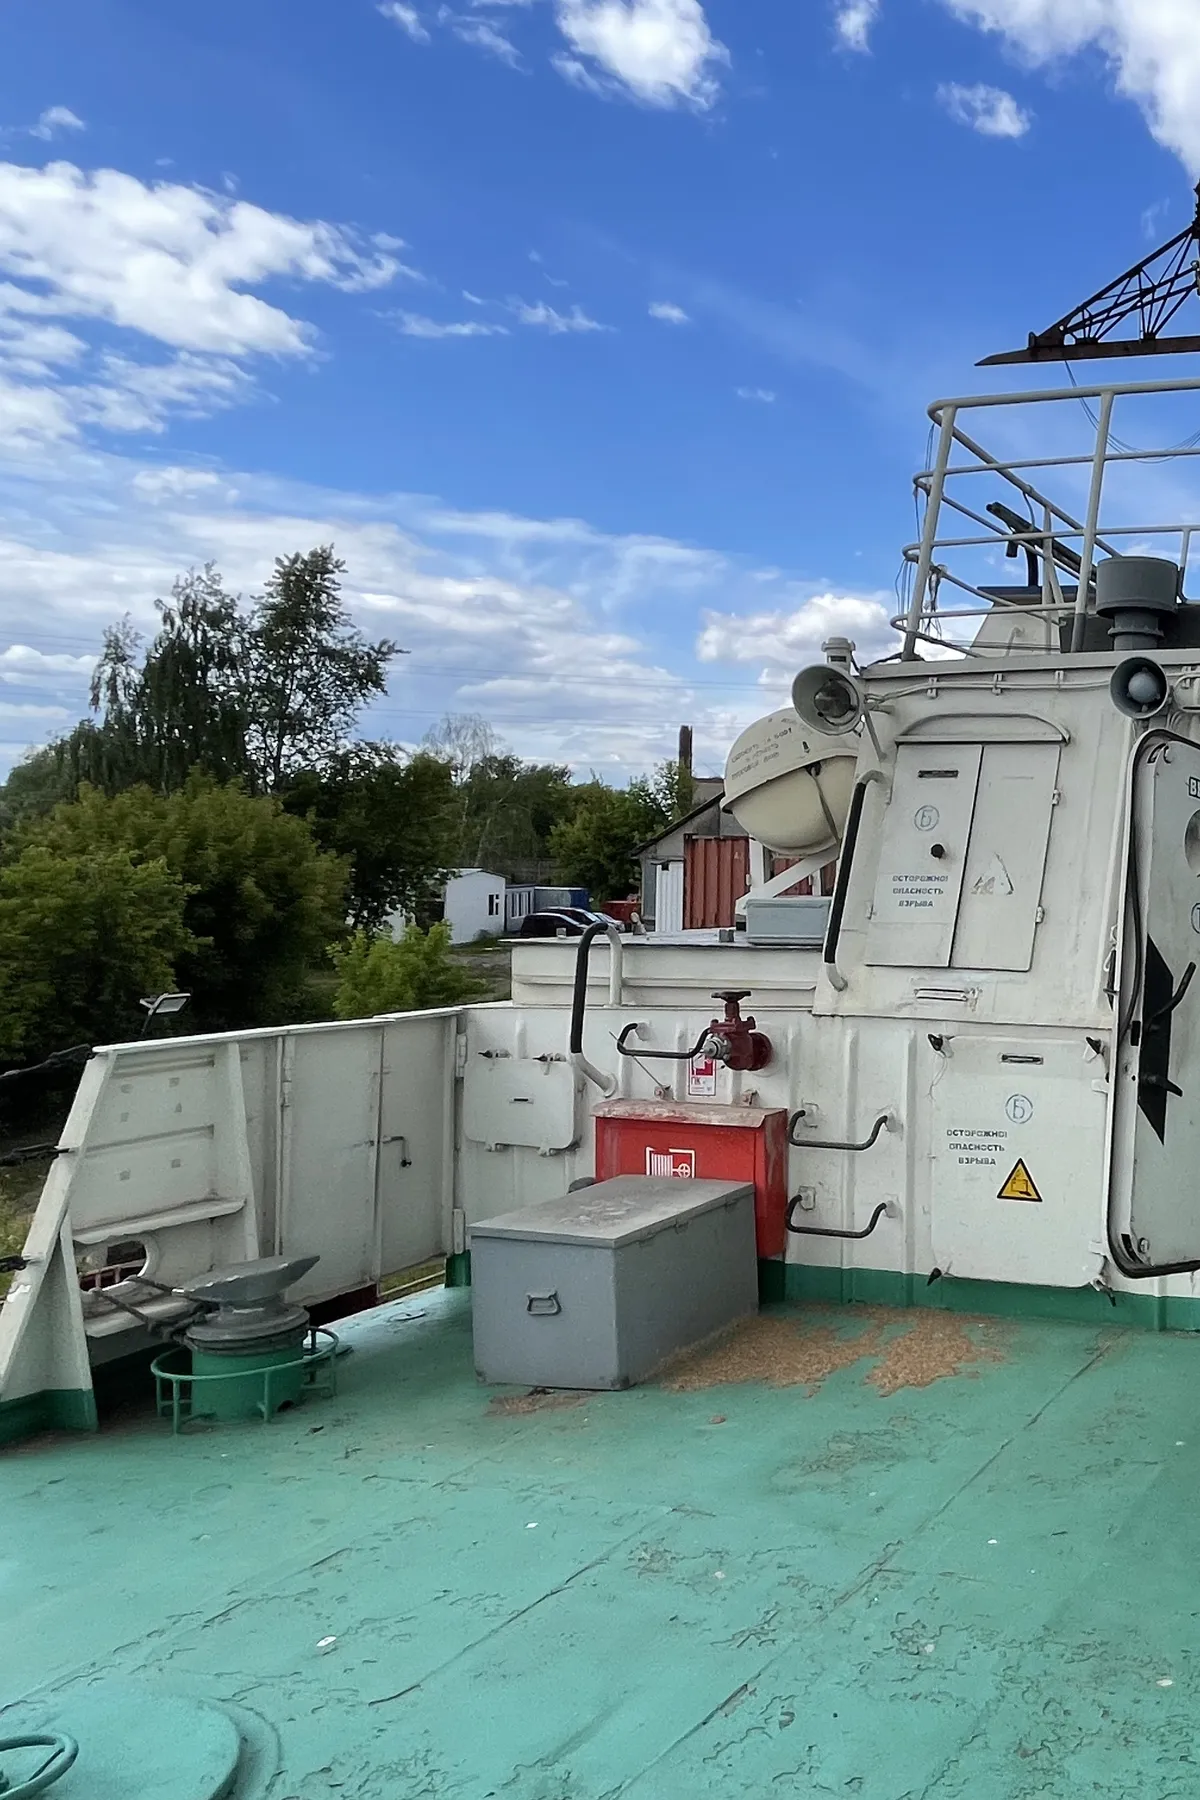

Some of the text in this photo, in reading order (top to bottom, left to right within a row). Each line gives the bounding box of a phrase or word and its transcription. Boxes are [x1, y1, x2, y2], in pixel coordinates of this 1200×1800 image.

[892, 887, 944, 895] ОПАСНОСТЬ
[949, 1143, 1005, 1152] ОПАСНОСТЬ
[958, 1157, 997, 1166] ВЗРЫВА
